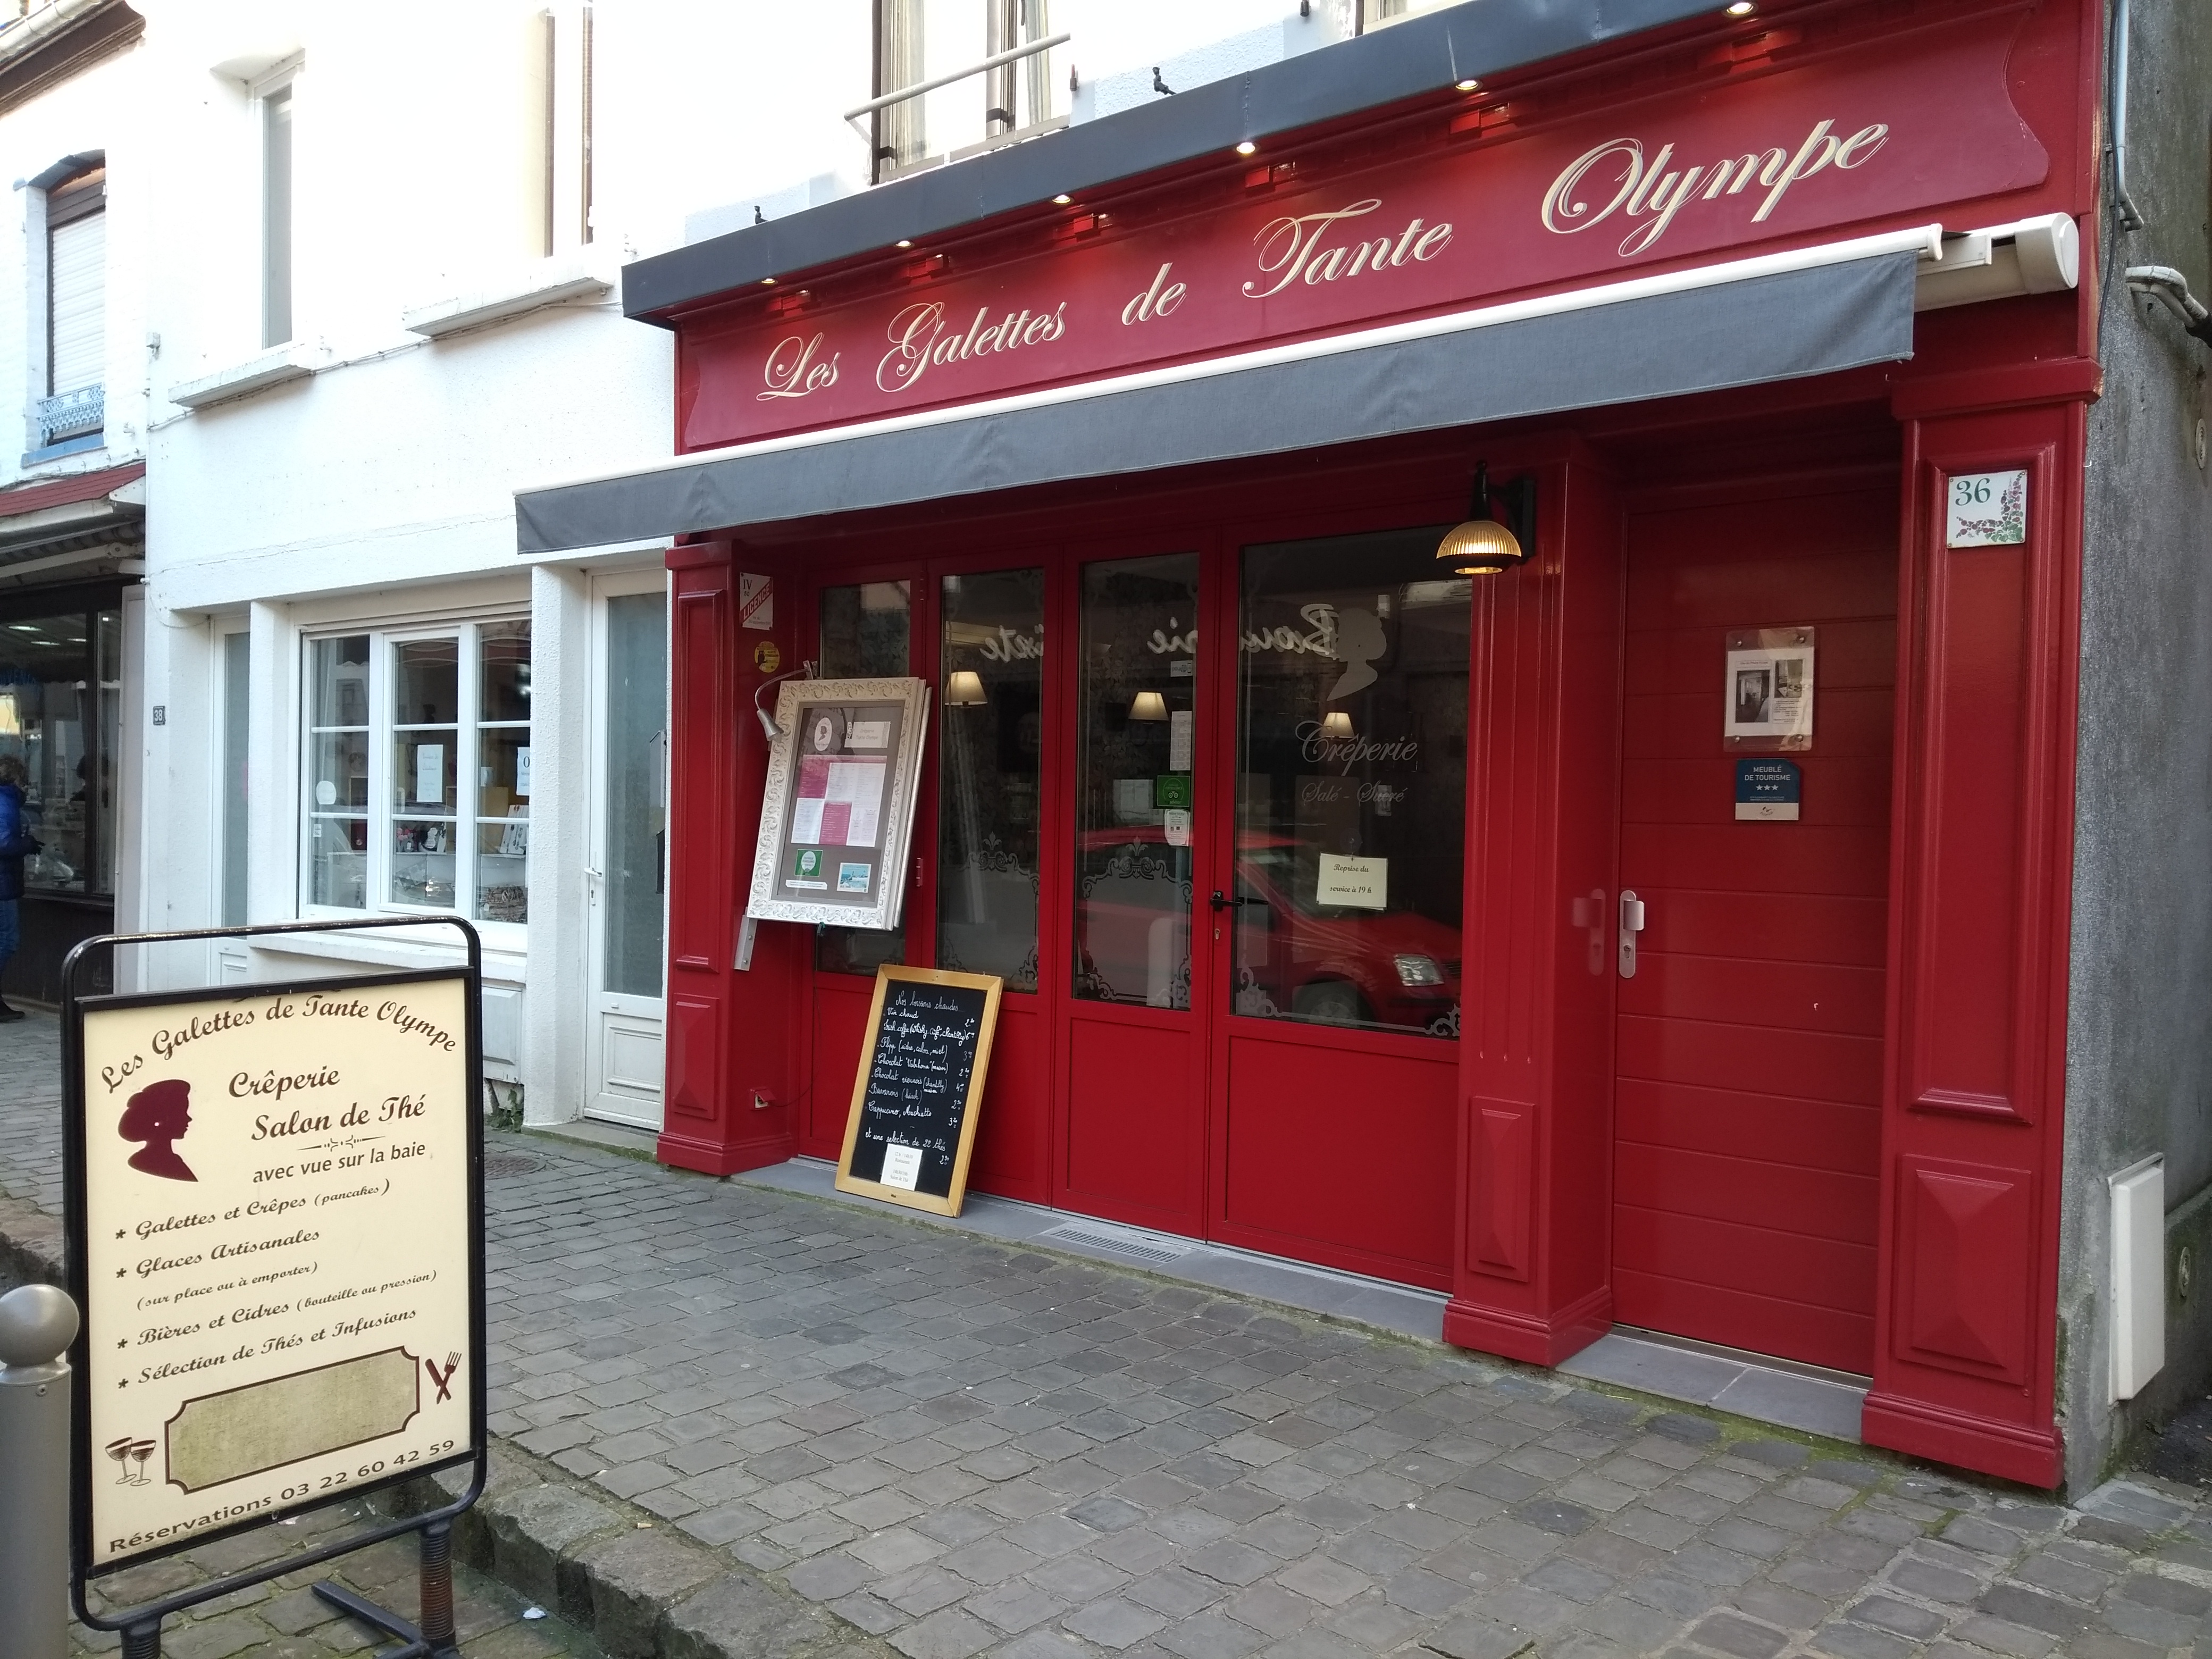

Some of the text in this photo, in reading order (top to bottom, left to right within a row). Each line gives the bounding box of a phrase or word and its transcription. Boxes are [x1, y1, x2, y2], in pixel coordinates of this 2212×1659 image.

[756, 118, 1889, 400] Les Galettes de Tante Olympe
[1955, 478, 1990, 506] 36
[743, 579, 752, 590] IV
[743, 583, 770, 618] LICENCE
[154, 709, 162, 721] 38
[1295, 720, 1418, 776] Crêperie
[1302, 781, 1341, 806] Salé
[1334, 864, 1359, 873] Reprise
[896, 991, 906, 1006] Nos
[910, 991, 932, 1009] boissons
[899, 1009, 919, 1019] chaud
[101, 995, 456, 1094] Les Galettes de Tante Olympe
[878, 1053, 903, 1066] Chocolat
[229, 1065, 340, 1100] Crêperie
[870, 1083, 898, 1097] Bavarois
[874, 1067, 899, 1080] Chocolat
[251, 1094, 426, 1141] Salon de Thé
[866, 1127, 872, 1138] et
[912, 1137, 920, 1146] de
[923, 1139, 931, 1147] 22
[933, 1138, 945, 1151] thés
[253, 1143, 426, 1184] avec vue sur la baie
[135, 1211, 216, 1240] Galettes
[224, 1206, 240, 1219] et
[247, 1199, 306, 1218] Crêpes
[136, 1229, 320, 1278] Glaces Artisanales
[137, 1261, 318, 1311] (sur place ou à emporter)
[137, 1269, 437, 1345] Bières et Cidres (bouteille ou pression)
[138, 1309, 416, 1384] Sélection de Thés et Infusions
[110, 1440, 455, 1553] Réservations 03 22 60 42 59
